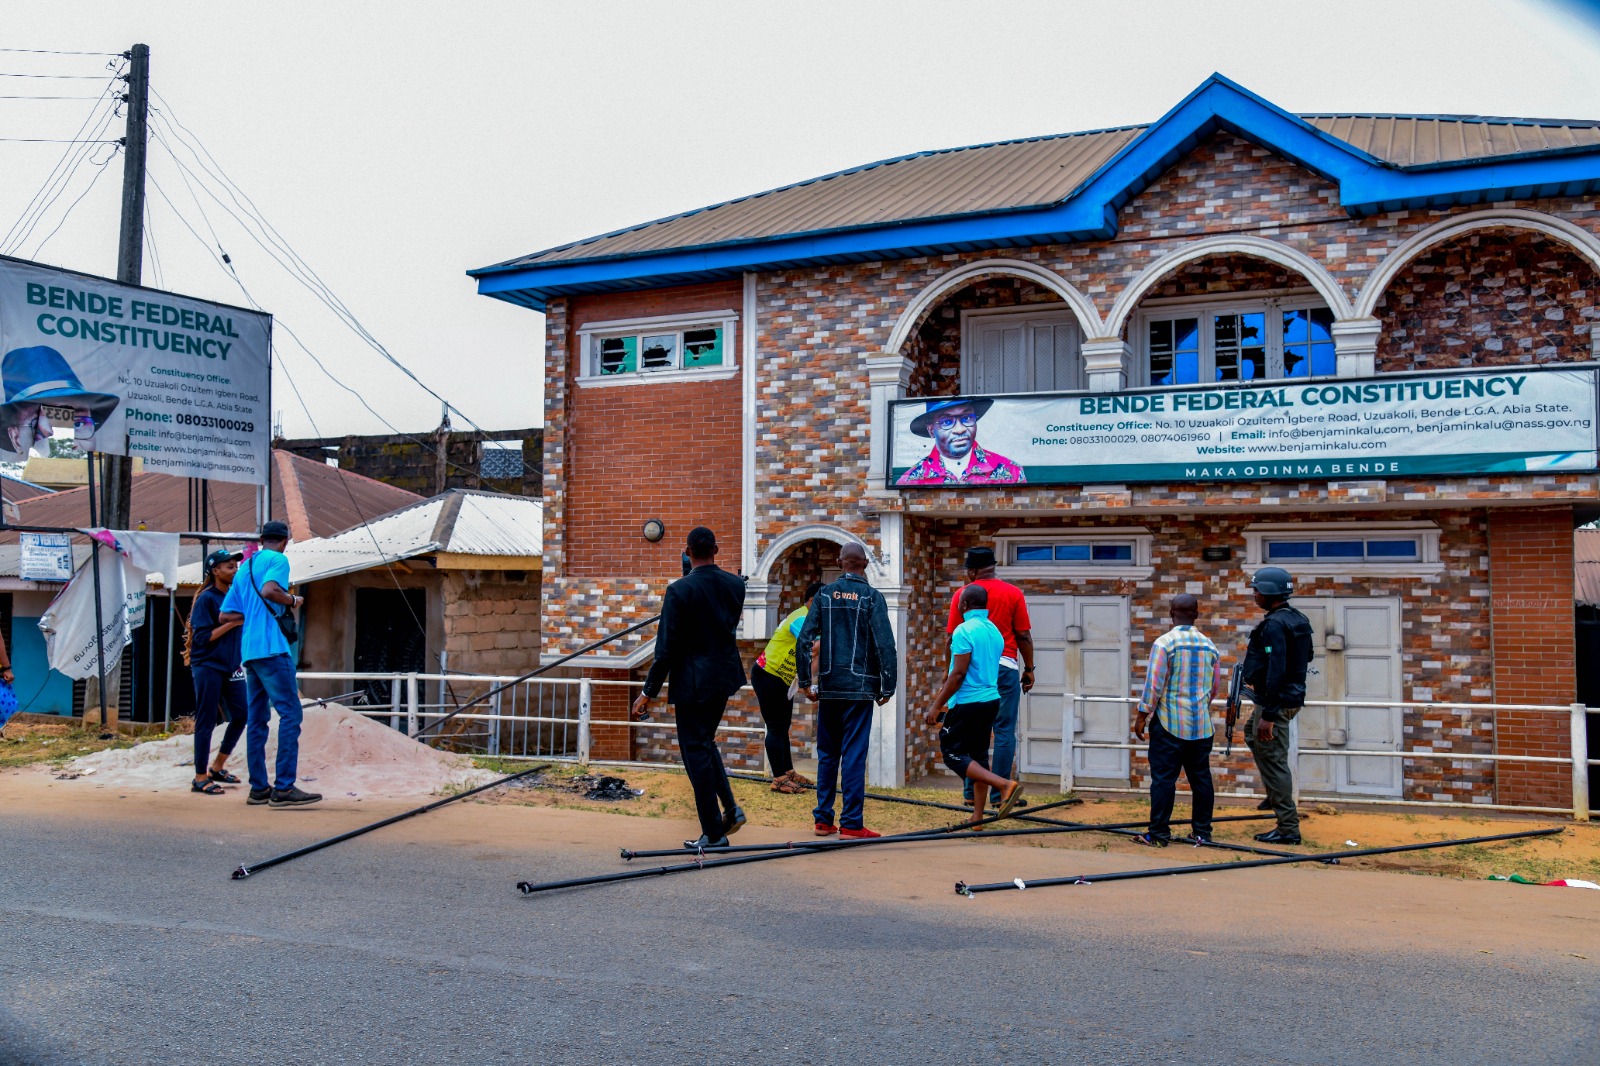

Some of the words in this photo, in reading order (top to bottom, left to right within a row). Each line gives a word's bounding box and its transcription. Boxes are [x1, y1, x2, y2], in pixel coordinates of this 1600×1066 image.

[26, 282, 123, 318] BENDE
[132, 300, 239, 339] FEDERAL
[36, 313, 232, 361] CONSTITUENCY
[150, 366, 205, 382] Constituency
[206, 374, 232, 384] Office:
[127, 391, 164, 404] Uzuakoli,
[166, 396, 192, 406] Bende
[216, 402, 233, 412] Abia
[133, 377, 142, 386] 10
[144, 379, 179, 390] Uzuakoli
[180, 384, 213, 395] Ozuitem
[239, 392, 260, 403] Road,
[1079, 394, 1165, 416] BENDE
[1173, 388, 1293, 413] FEDERAL
[1300, 375, 1528, 406] CONSTITUENCY
[125, 408, 172, 423] Phone:
[176, 413, 254, 432] 08033100029
[1046, 422, 1114, 433] Constituency
[1116, 420, 1152, 431] Office:
[1155, 420, 1172, 429] No.
[1175, 420, 1186, 428] 10
[1188, 416, 1234, 428] Uzuakoli
[1237, 414, 1286, 426] Ozuitem
[1288, 413, 1325, 426] Igbere
[1328, 412, 1360, 423] Road,
[1363, 408, 1417, 422] Uzuakoli,
[1421, 406, 1461, 418] Bende
[1464, 405, 1500, 416] L.G.A.
[1503, 404, 1531, 414] Abia
[1535, 403, 1572, 414] State.
[129, 428, 156, 438] Email:
[158, 430, 251, 447] info@benjaminkalu.com
[1032, 436, 1068, 446] Phone:
[1070, 434, 1138, 446] 08033100029,
[1140, 432, 1210, 444] 08074061960
[1231, 430, 1266, 440] Email:
[1268, 425, 1414, 439] info@benjaminkalu.com,
[1416, 418, 1592, 434] benjaminkalu@nass.gov.ng
[164, 445, 255, 460] www.benjaminkalu.com
[1196, 444, 1245, 455] Website:
[1248, 439, 1388, 454] www.benjaminkalu.com
[1186, 466, 1237, 478] MAKA
[1244, 464, 1323, 476] ODINMA
[1331, 462, 1400, 474] BENDE
